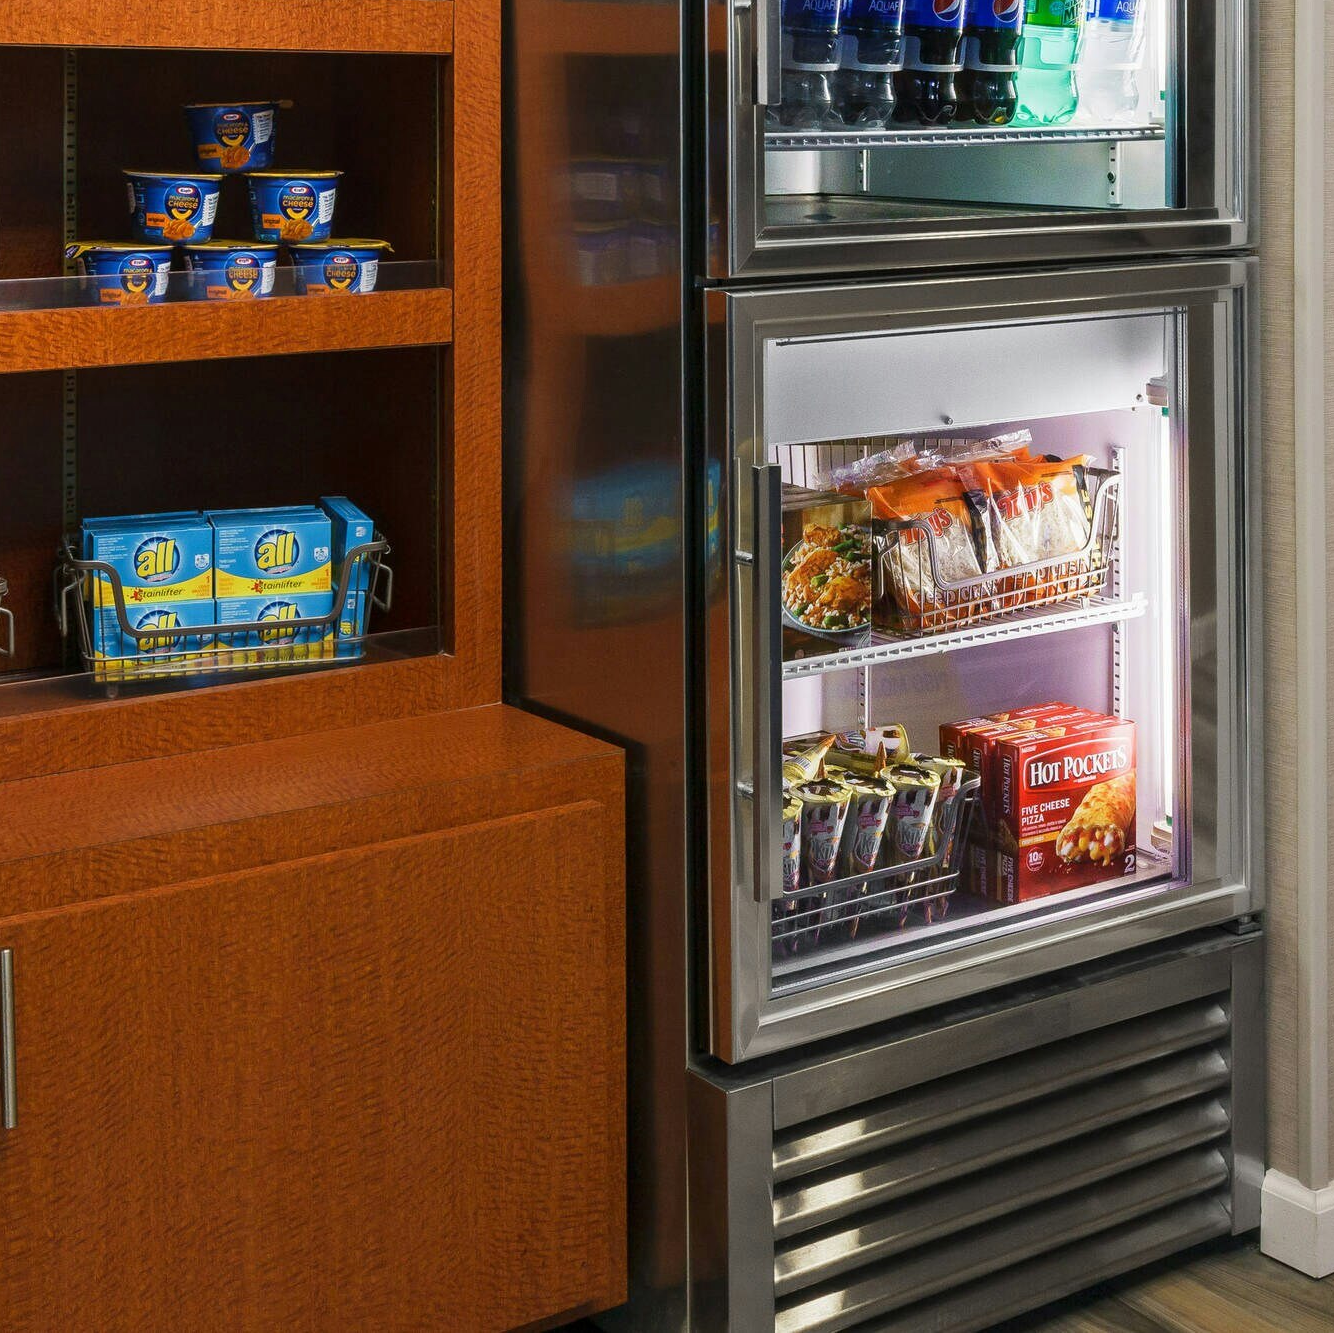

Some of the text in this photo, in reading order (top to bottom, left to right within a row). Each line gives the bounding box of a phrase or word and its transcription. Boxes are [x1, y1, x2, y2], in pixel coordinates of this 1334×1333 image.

[136, 538, 177, 579] all
[256, 531, 296, 574] all
[259, 579, 303, 591] stainlifter
[1030, 744, 1128, 787] HOT POCKETS
[1021, 797, 1071, 816] FIVE CHEESE
[1021, 815, 1045, 827] PIZZA
[1124, 853, 1135, 874] 2
